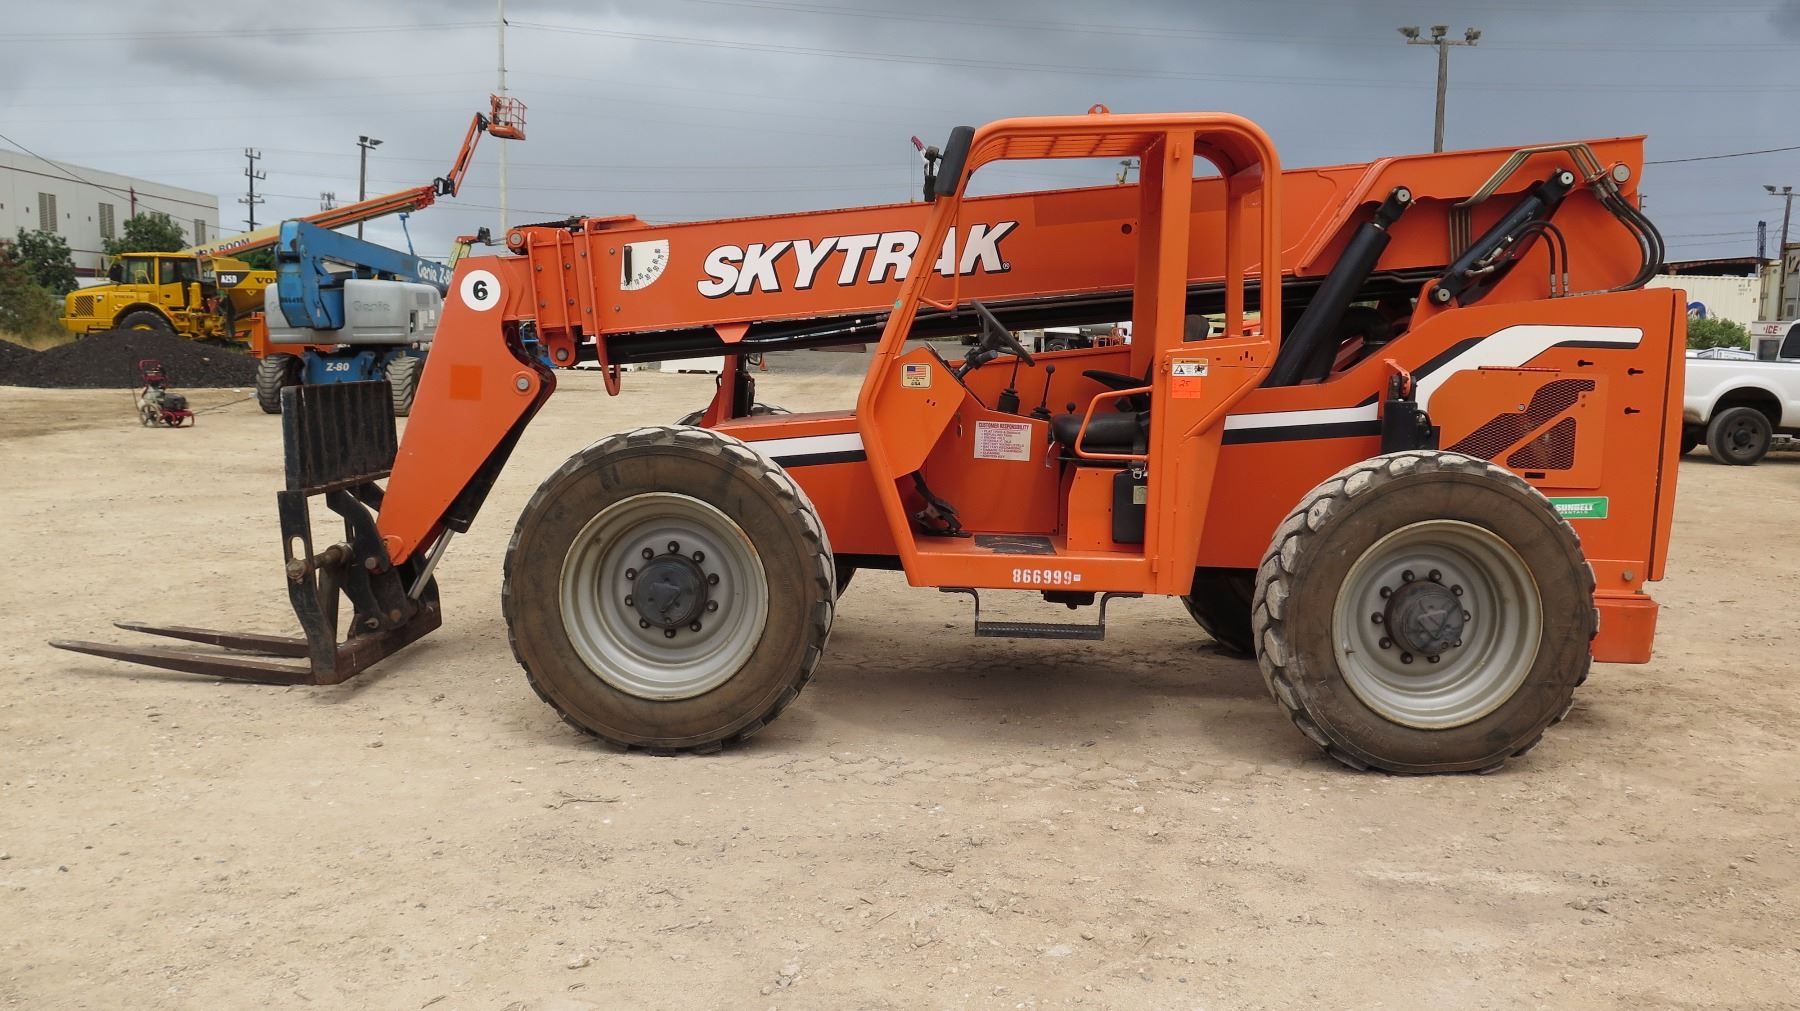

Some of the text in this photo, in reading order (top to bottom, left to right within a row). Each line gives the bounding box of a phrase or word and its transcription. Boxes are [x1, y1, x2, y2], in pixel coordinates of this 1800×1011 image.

[697, 221, 1019, 298] SKYTRAK
[417, 260, 437, 281] Genie
[472, 280, 489, 301] 6
[1765, 325, 1779, 335] ICE
[326, 362, 350, 371] Z-80
[1012, 568, 1072, 585] 866999
